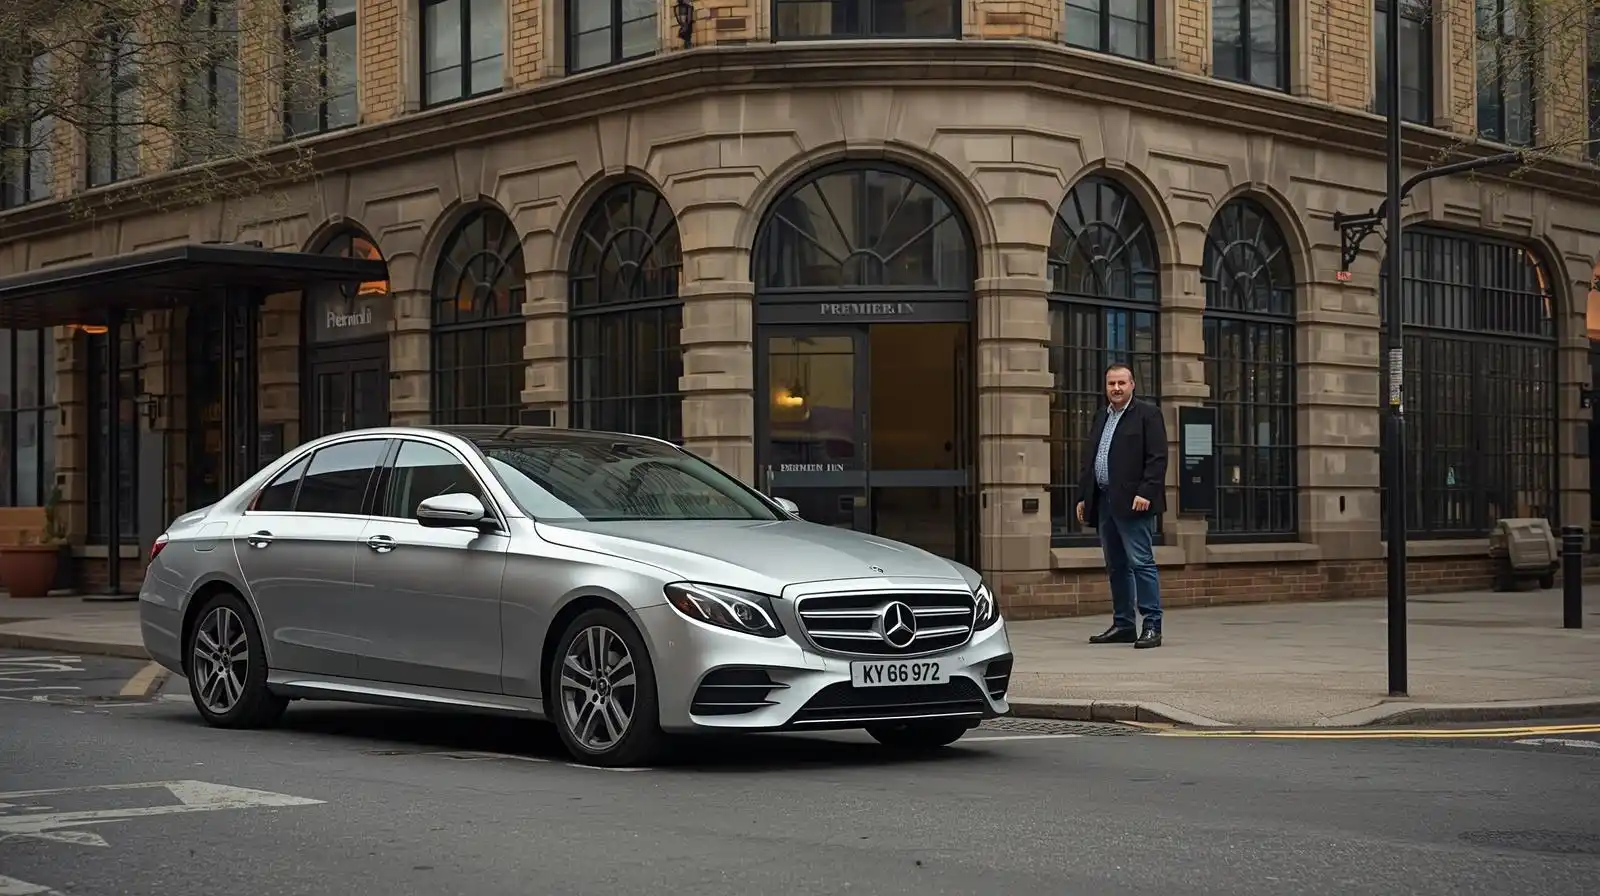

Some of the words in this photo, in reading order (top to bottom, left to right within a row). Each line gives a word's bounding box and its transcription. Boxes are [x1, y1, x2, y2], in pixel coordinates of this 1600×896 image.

[863, 664, 884, 684] KY
[887, 664, 908, 682] 66
[911, 662, 940, 682] 972
